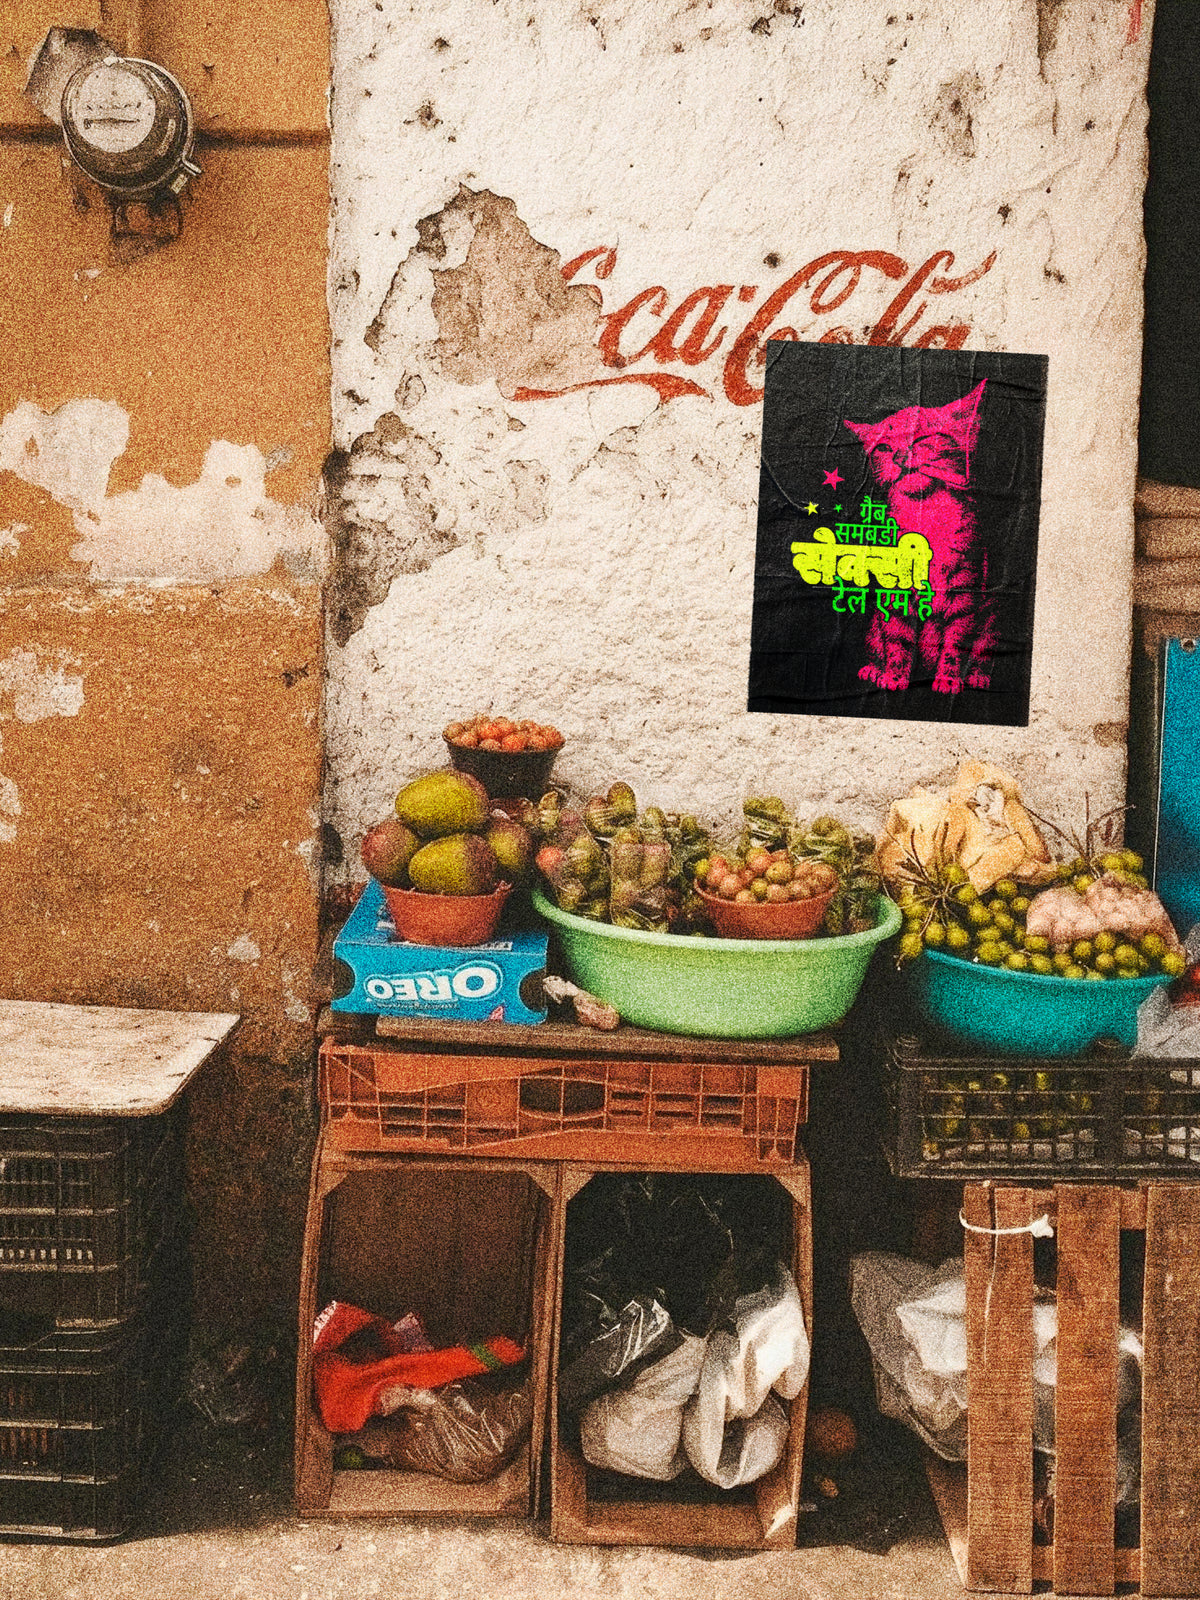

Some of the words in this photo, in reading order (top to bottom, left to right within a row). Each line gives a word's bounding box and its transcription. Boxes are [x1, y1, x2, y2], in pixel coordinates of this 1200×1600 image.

[859, 495, 888, 525] ग्रैब
[834, 517, 900, 546] समबडी
[790, 526, 934, 590] सेक्सी
[831, 576, 870, 614] टेल
[874, 588, 912, 622] एम
[917, 580, 936, 622] हे
[366, 965, 499, 1001] OREO
